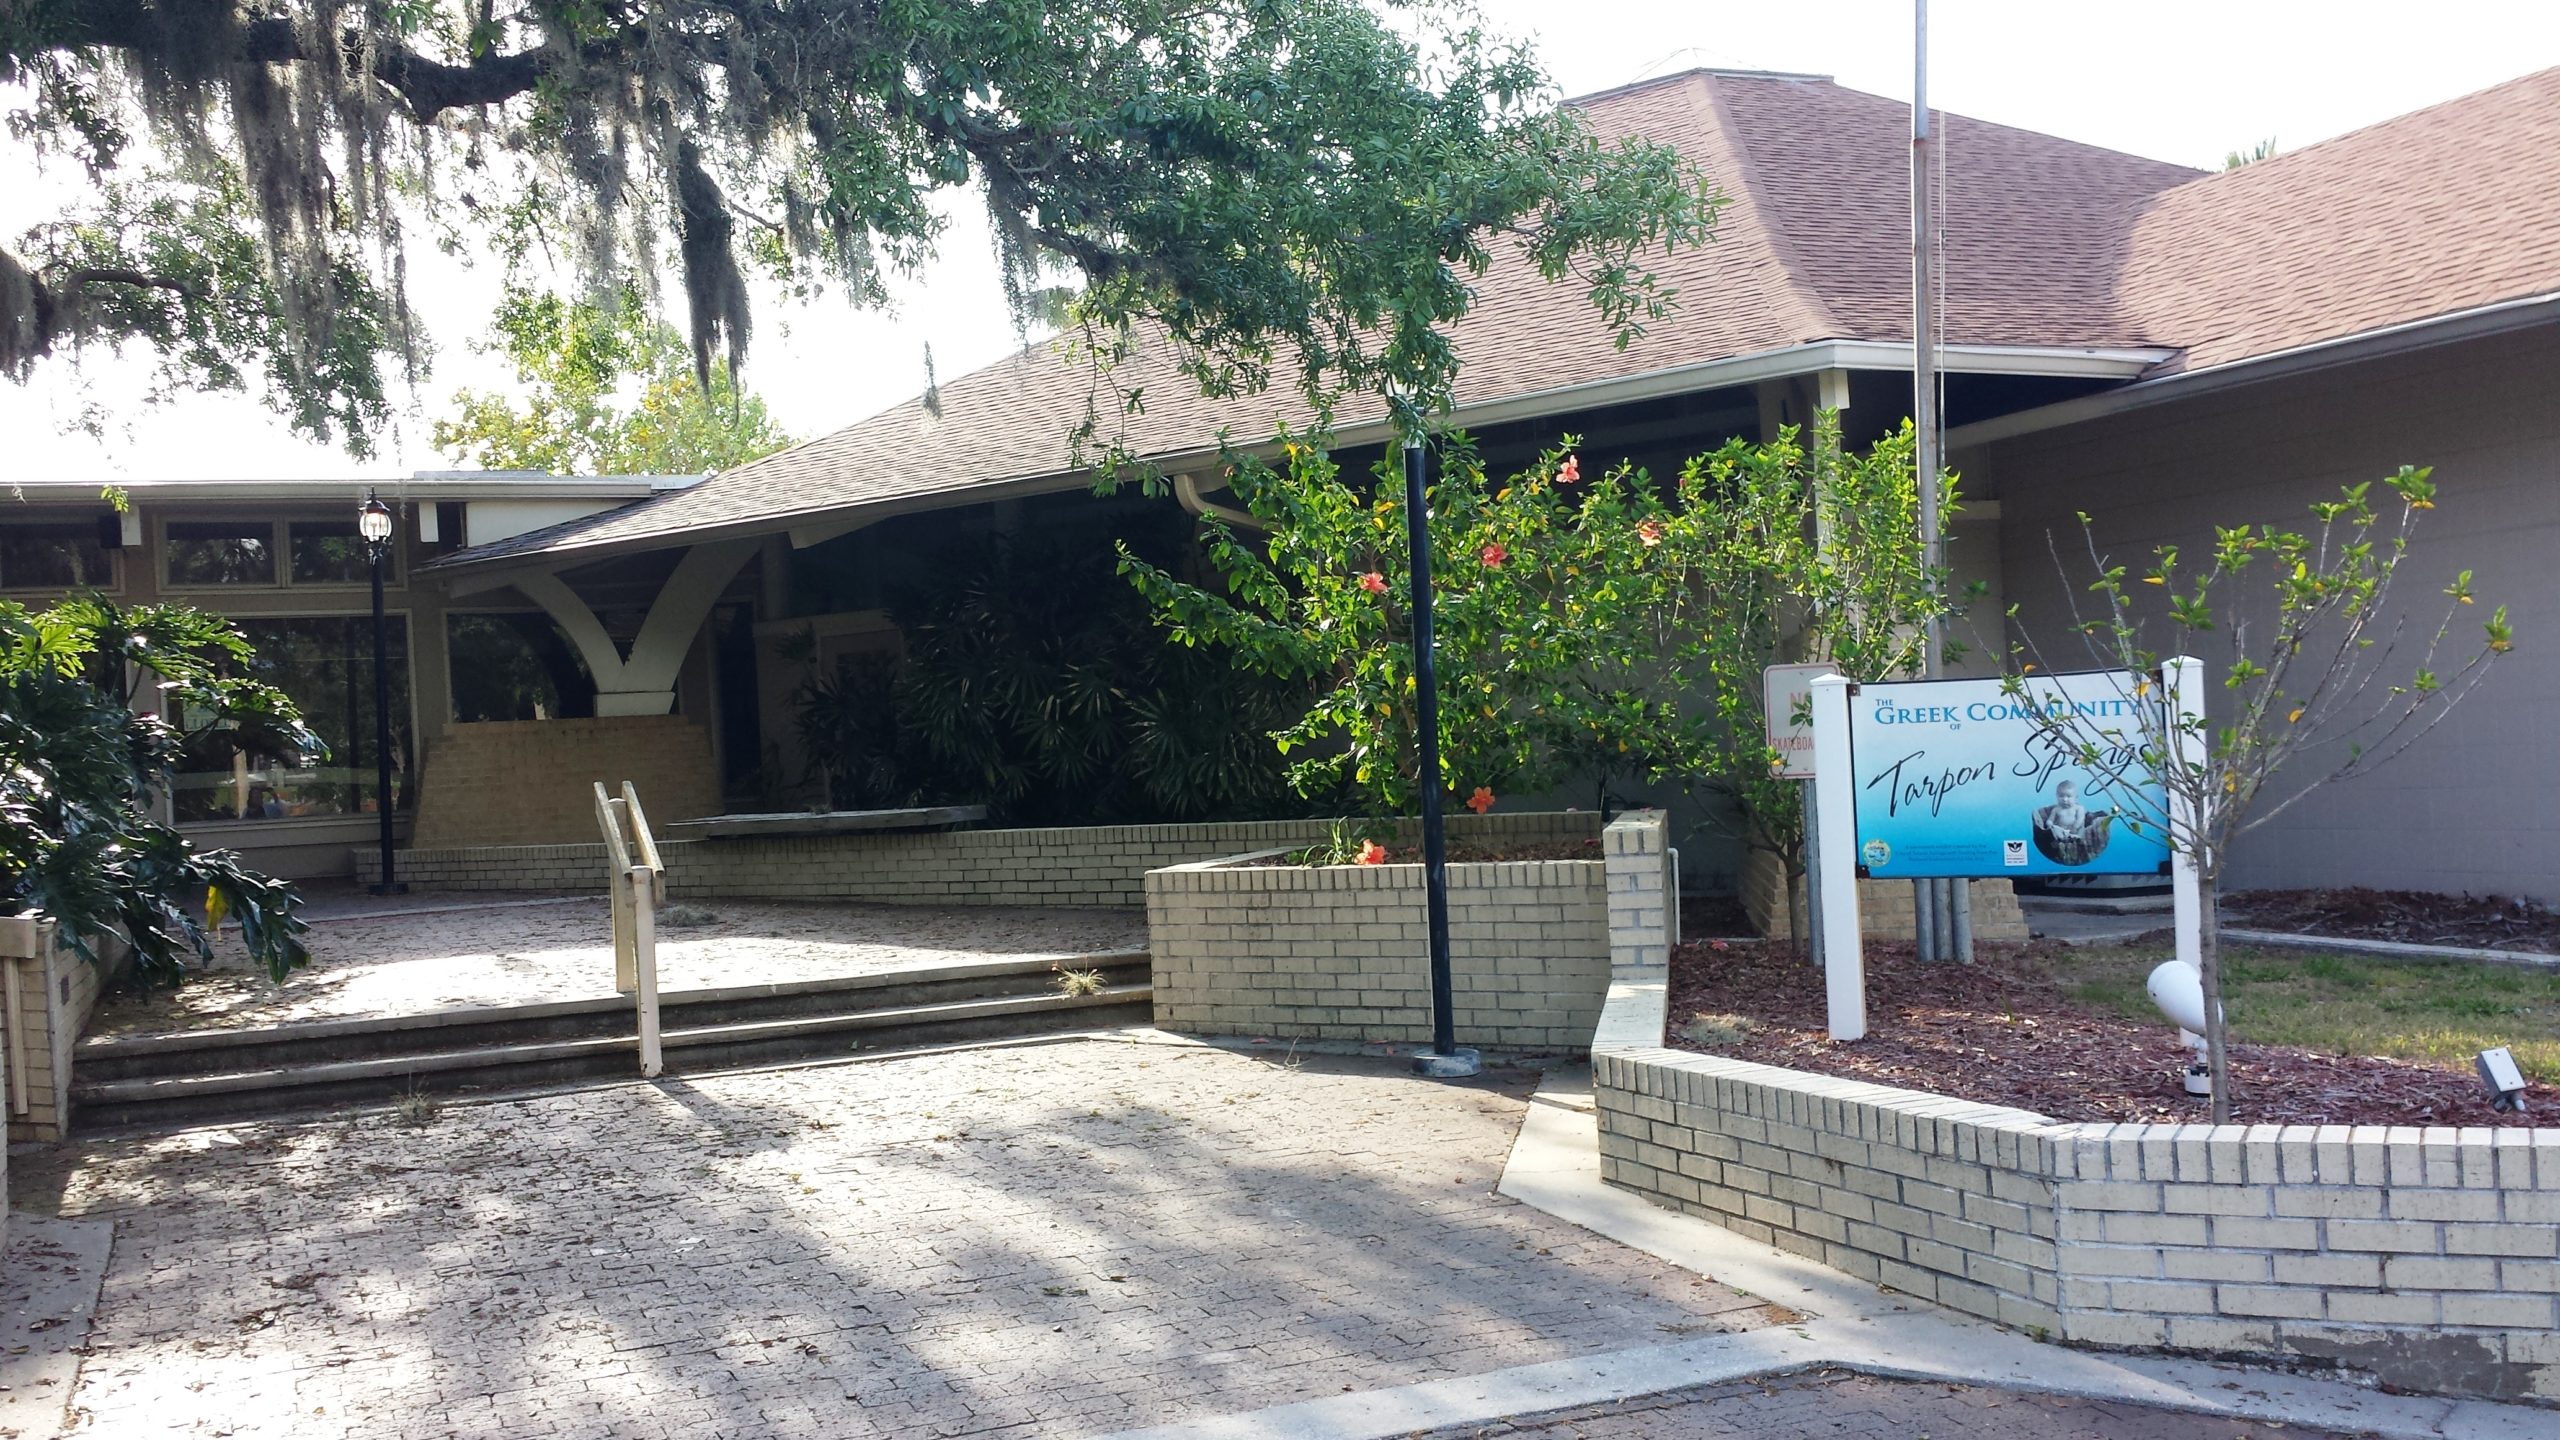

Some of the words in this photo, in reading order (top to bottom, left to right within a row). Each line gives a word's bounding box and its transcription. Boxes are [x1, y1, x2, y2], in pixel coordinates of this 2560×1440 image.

[1790, 692, 1812, 713] N
[1875, 698, 1893, 706] THE
[1875, 706, 1960, 724] GREEK
[1773, 736, 1814, 750] SKATEBOA
[1867, 750, 1995, 818] Tarpon
[2012, 724, 2152, 796] Spngs
